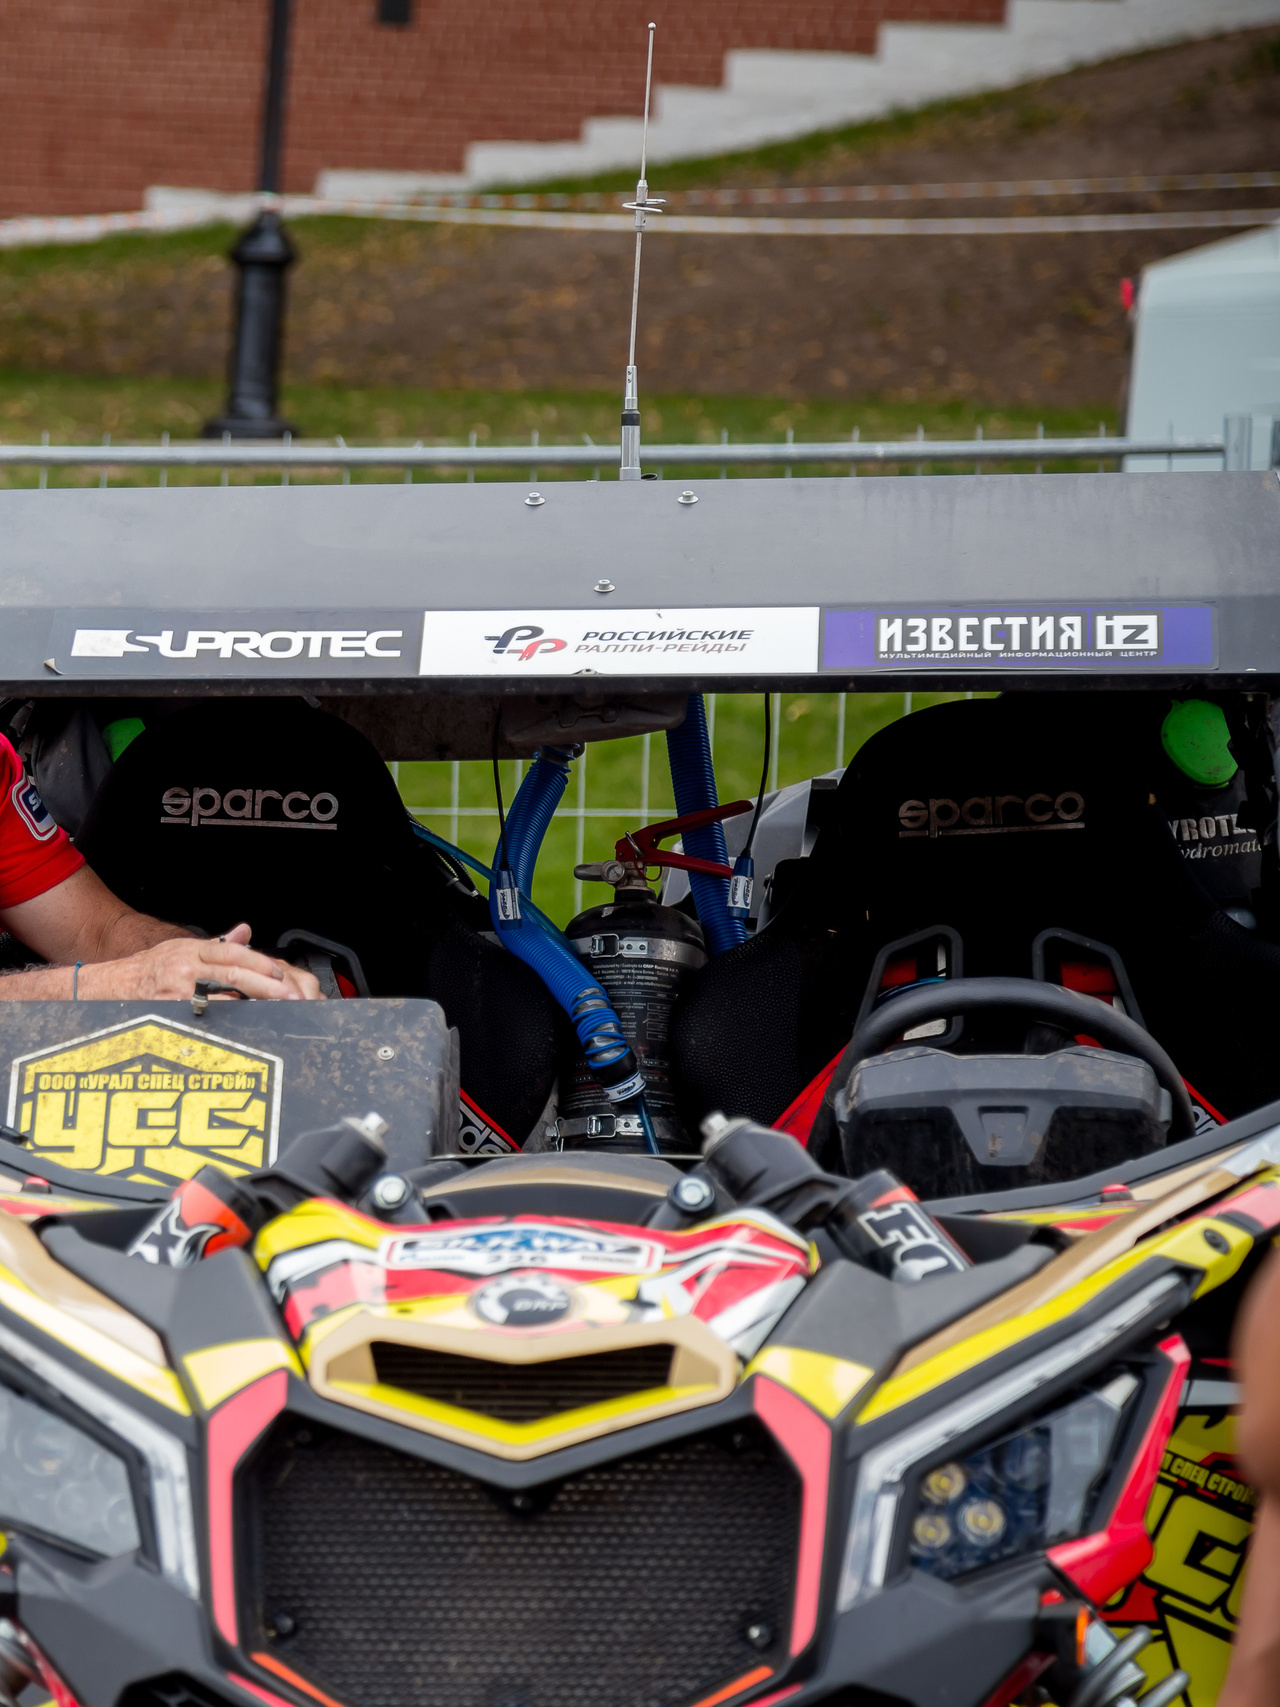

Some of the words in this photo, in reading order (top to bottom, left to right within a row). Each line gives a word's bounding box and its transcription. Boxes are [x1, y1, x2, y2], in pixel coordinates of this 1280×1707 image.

[122, 629, 403, 659] SUPROTEC
[574, 641, 747, 655] РАЛЛИ-РЕЙДЫ
[582, 628, 755, 642] РОССИЙСКИЕ
[879, 616, 1083, 651] ИЗВЕСТИЯ
[879, 651, 992, 659] МУЛЬТИМЕДИЙНЫЙ
[999, 650, 1113, 658] ИНФОРМАЦИОННЫЙ
[1120, 650, 1158, 658] ЦЕНТР
[161, 787, 339, 829] sparco
[898, 791, 1085, 838] sparco
[38, 1073, 77, 1091] ООО
[79, 1073, 135, 1091] «УРАЛ
[137, 1073, 186, 1092] СПЕЦ
[188, 1071, 256, 1091] СТРОЙ»
[33, 1091, 254, 1170] УСС
[1170, 1457, 1210, 1489] СПЕЦ
